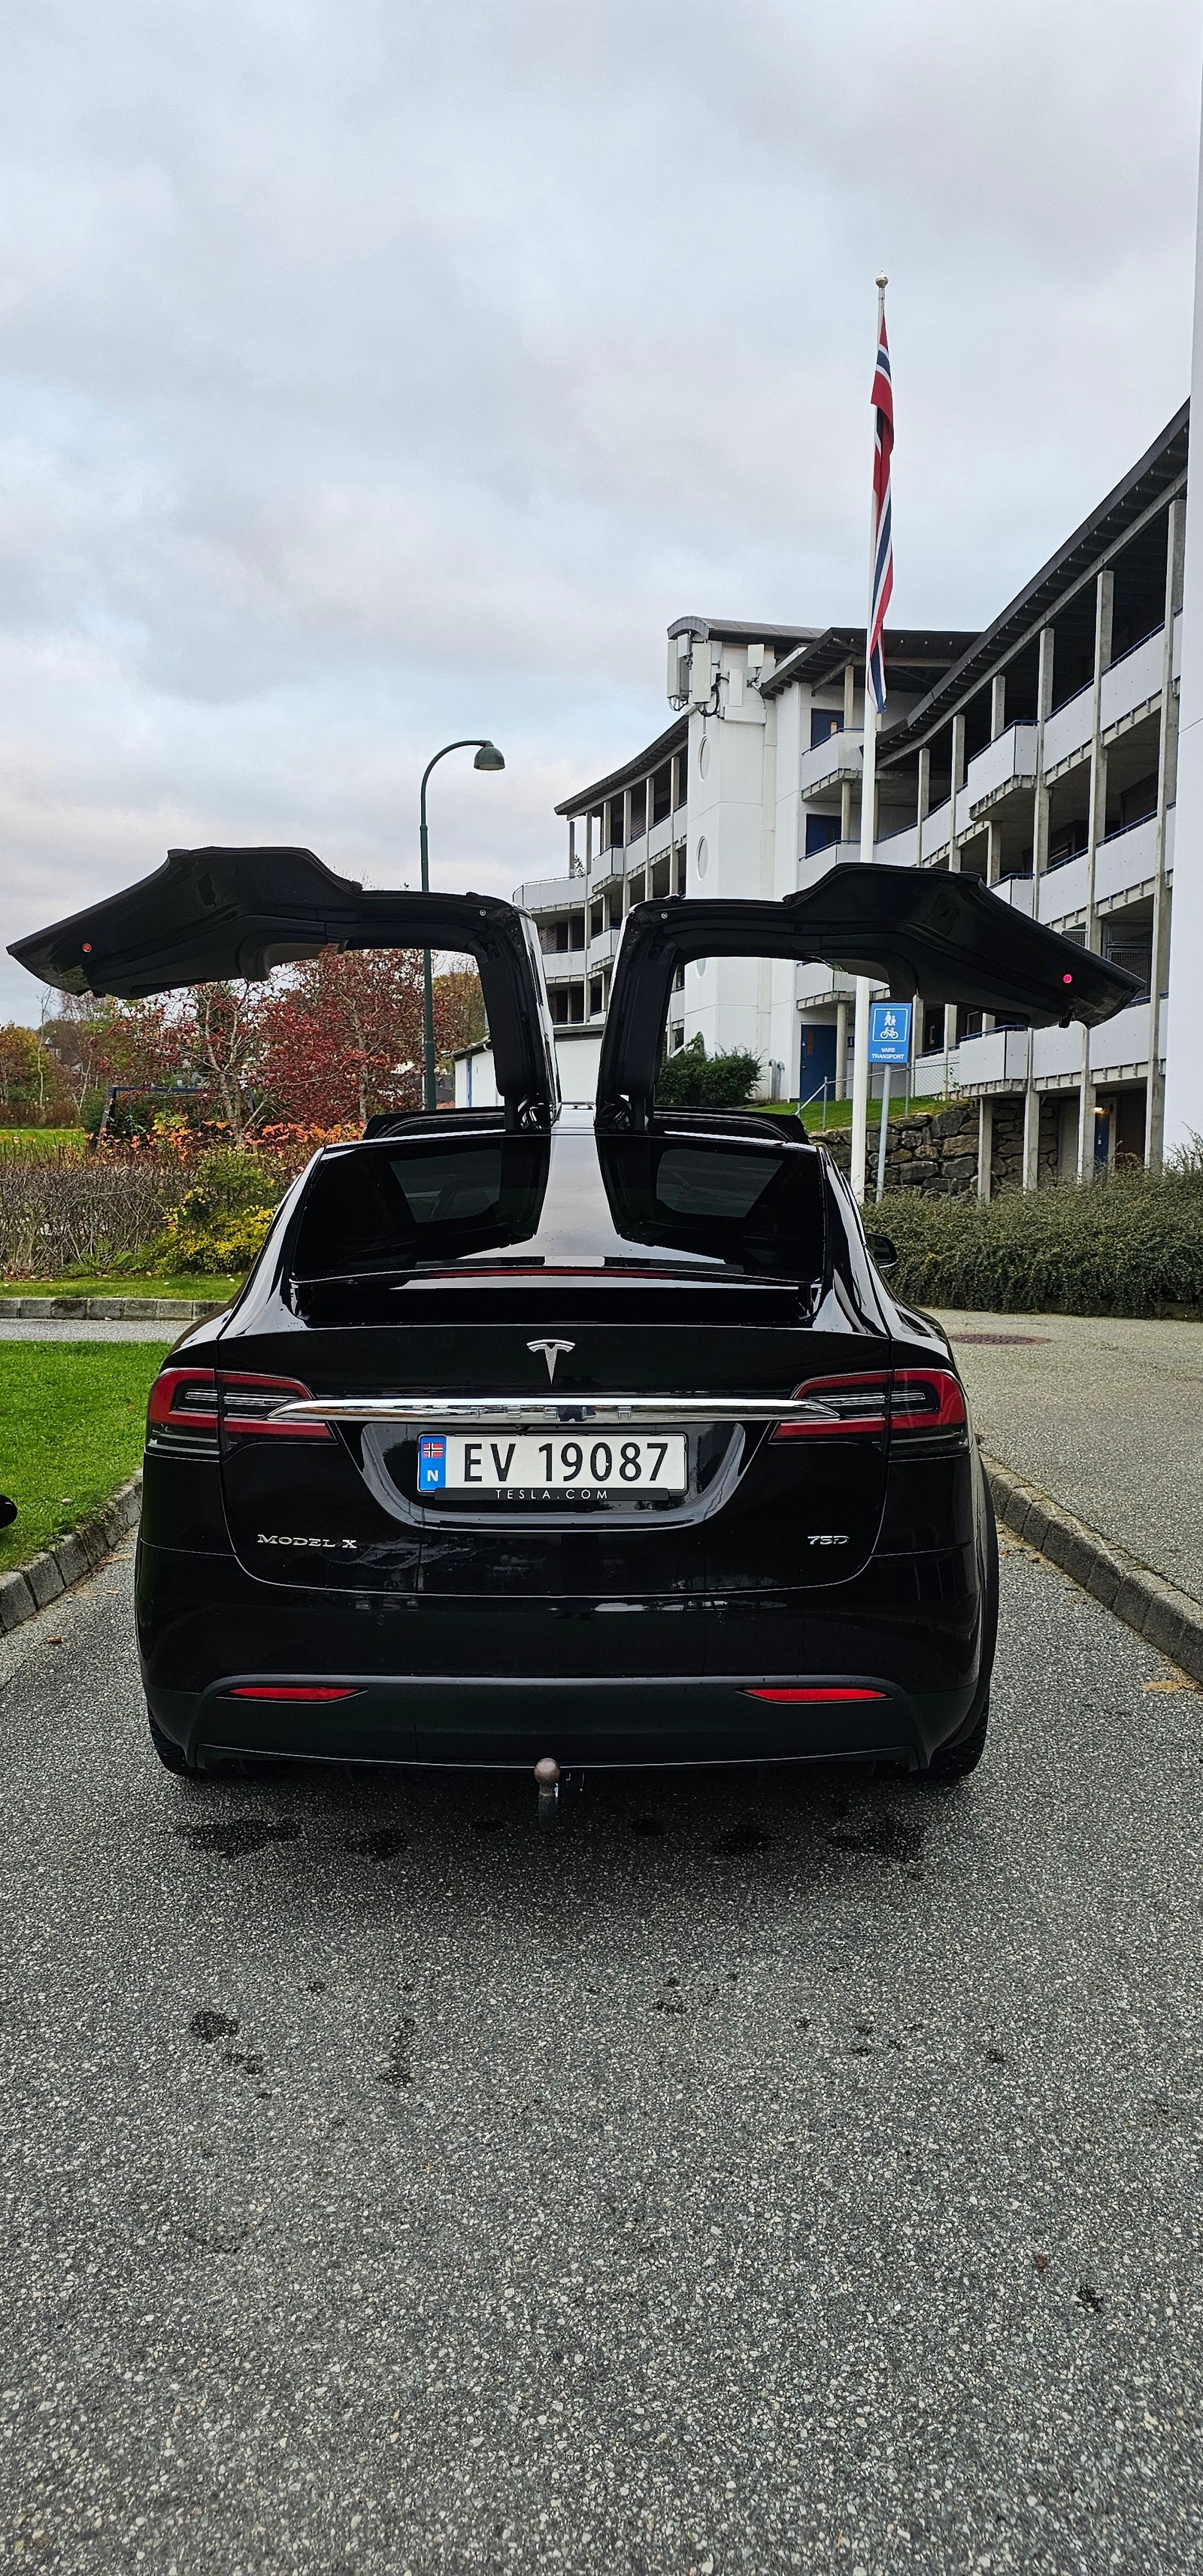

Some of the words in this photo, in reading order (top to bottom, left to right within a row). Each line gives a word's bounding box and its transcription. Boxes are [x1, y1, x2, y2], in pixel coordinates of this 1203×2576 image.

[464, 1443, 517, 1483] EV
[538, 1442, 668, 1482] 19087
[427, 1470, 438, 1482] N
[495, 1489, 608, 1500] TESLA.COM
[257, 1534, 336, 1547] MODEL
[342, 1539, 357, 1549] X
[807, 1535, 850, 1545] 75D
